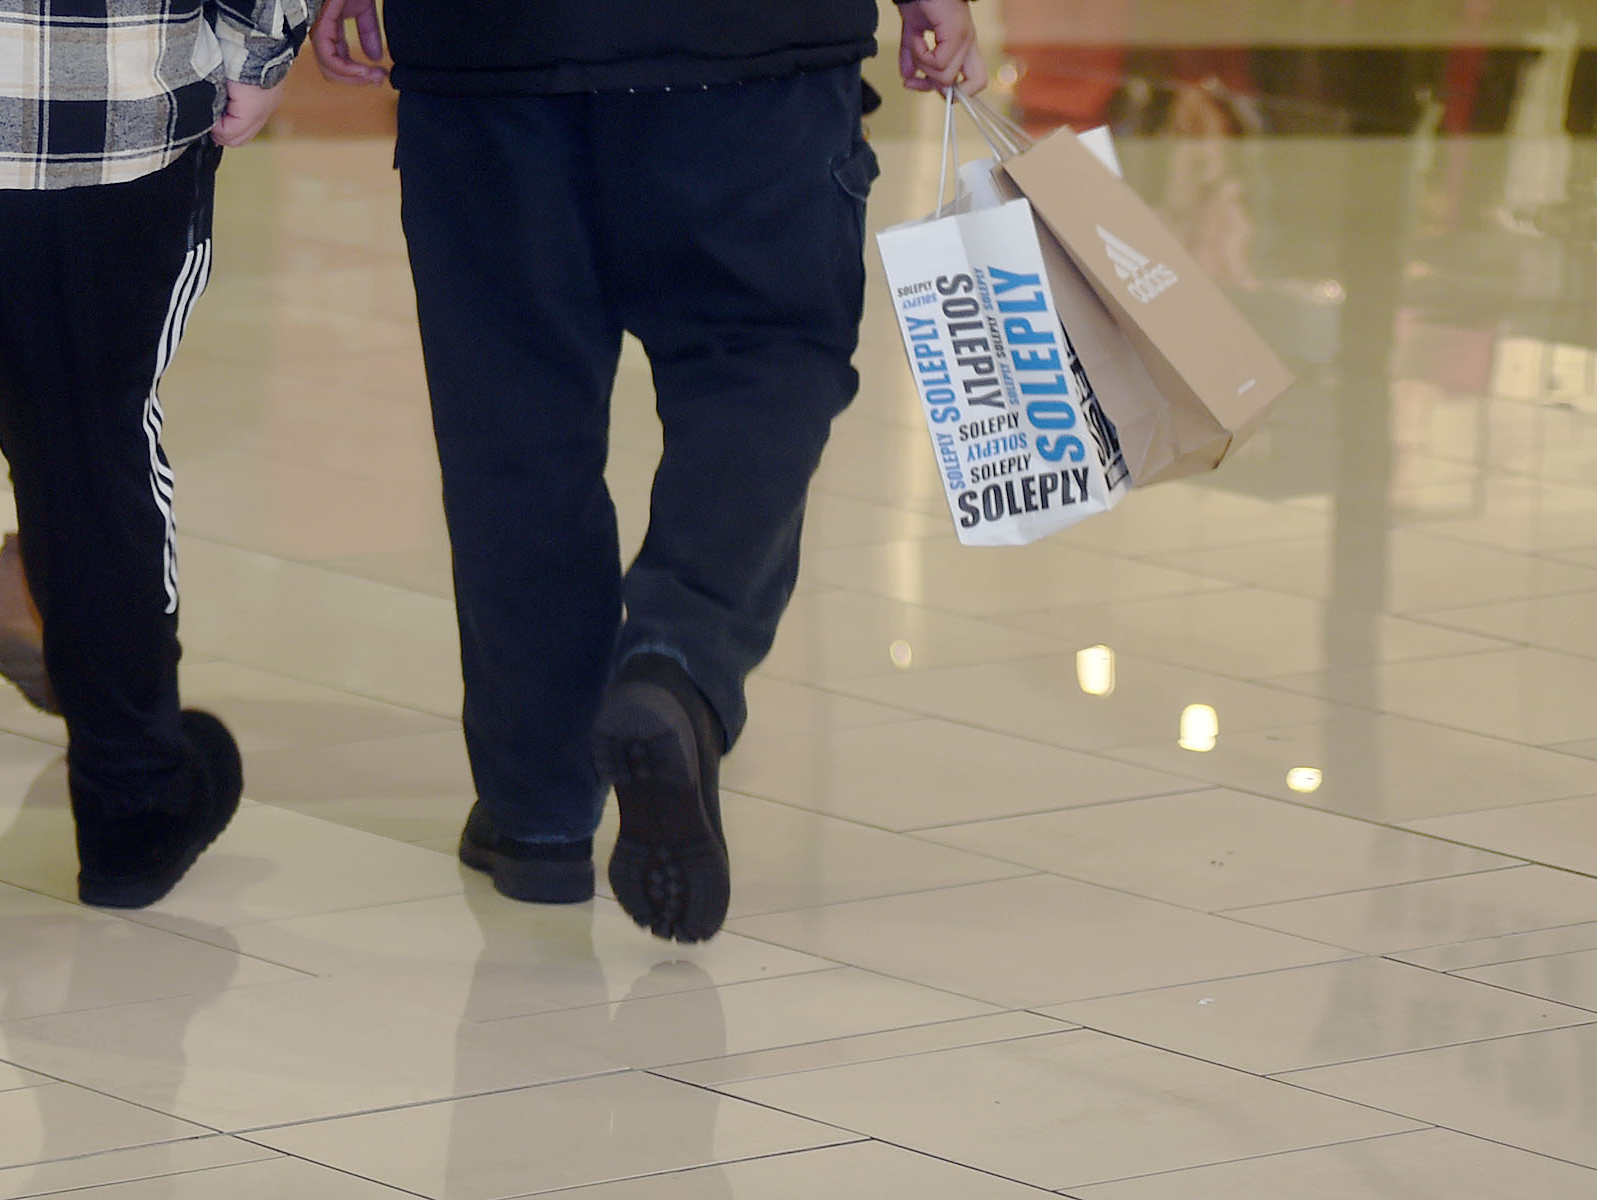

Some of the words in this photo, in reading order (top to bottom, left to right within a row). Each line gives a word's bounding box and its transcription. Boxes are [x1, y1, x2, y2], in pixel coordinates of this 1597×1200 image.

[897, 280, 933, 298] SOLEPLY
[936, 273, 1005, 410] SOLEPLY
[985, 317, 1006, 358] SOLEPLY
[905, 316, 961, 424] SOLEPLY
[987, 266, 1086, 463] SOLEPLY
[958, 412, 1020, 442] SOLEPLY
[966, 432, 1027, 462] SOLEPLY
[937, 432, 966, 490] SOLEPLY
[971, 453, 1032, 484] SOLEPLY
[958, 466, 1090, 529] SOLEPLY
